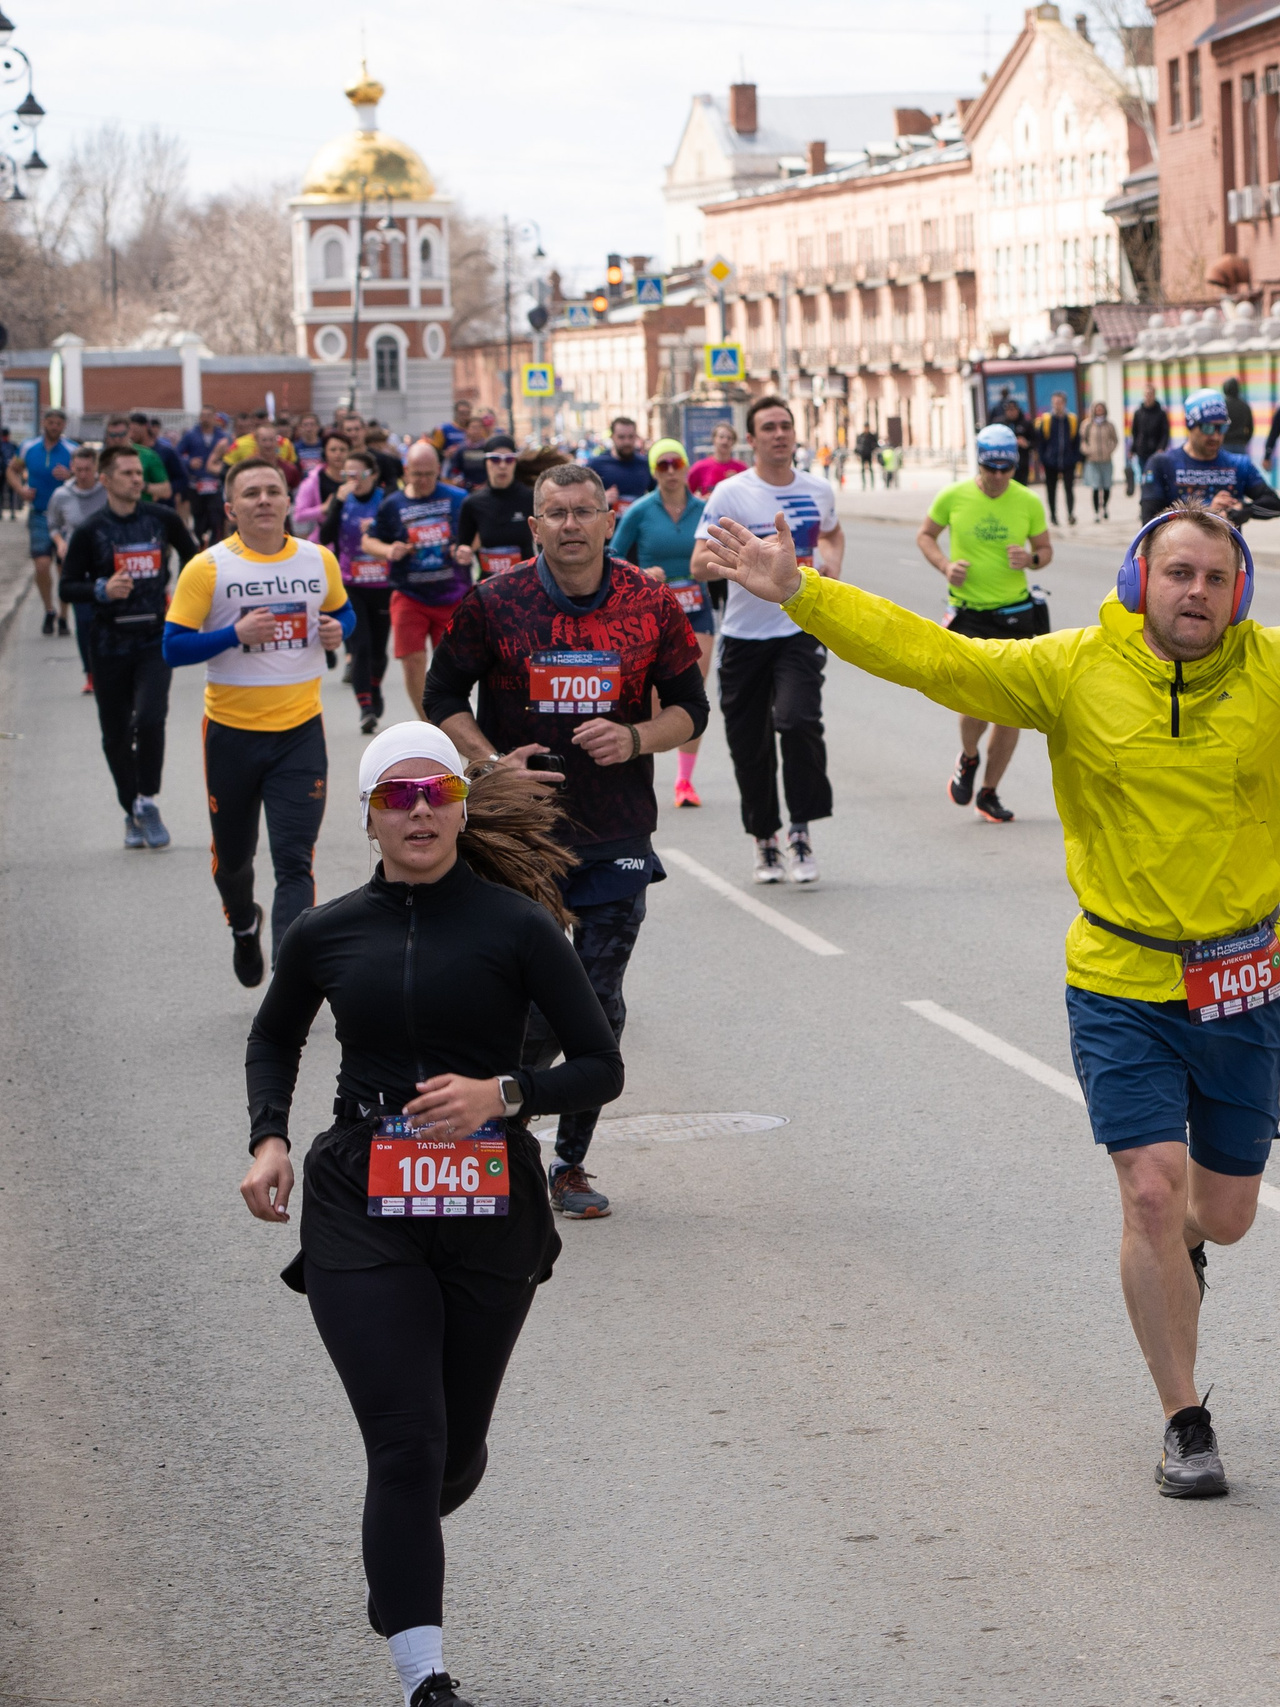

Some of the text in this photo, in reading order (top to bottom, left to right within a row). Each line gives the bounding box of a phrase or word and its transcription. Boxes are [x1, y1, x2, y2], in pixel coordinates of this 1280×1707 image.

[550, 676, 601, 699] 1700
[1224, 936, 1260, 949] ПРОСТО
[1221, 953, 1253, 966] АЛЕКСЕЙ
[1208, 958, 1272, 1000] 1405
[416, 1142, 456, 1150] ТАТЬЯНА
[398, 1156, 480, 1192] 1046
